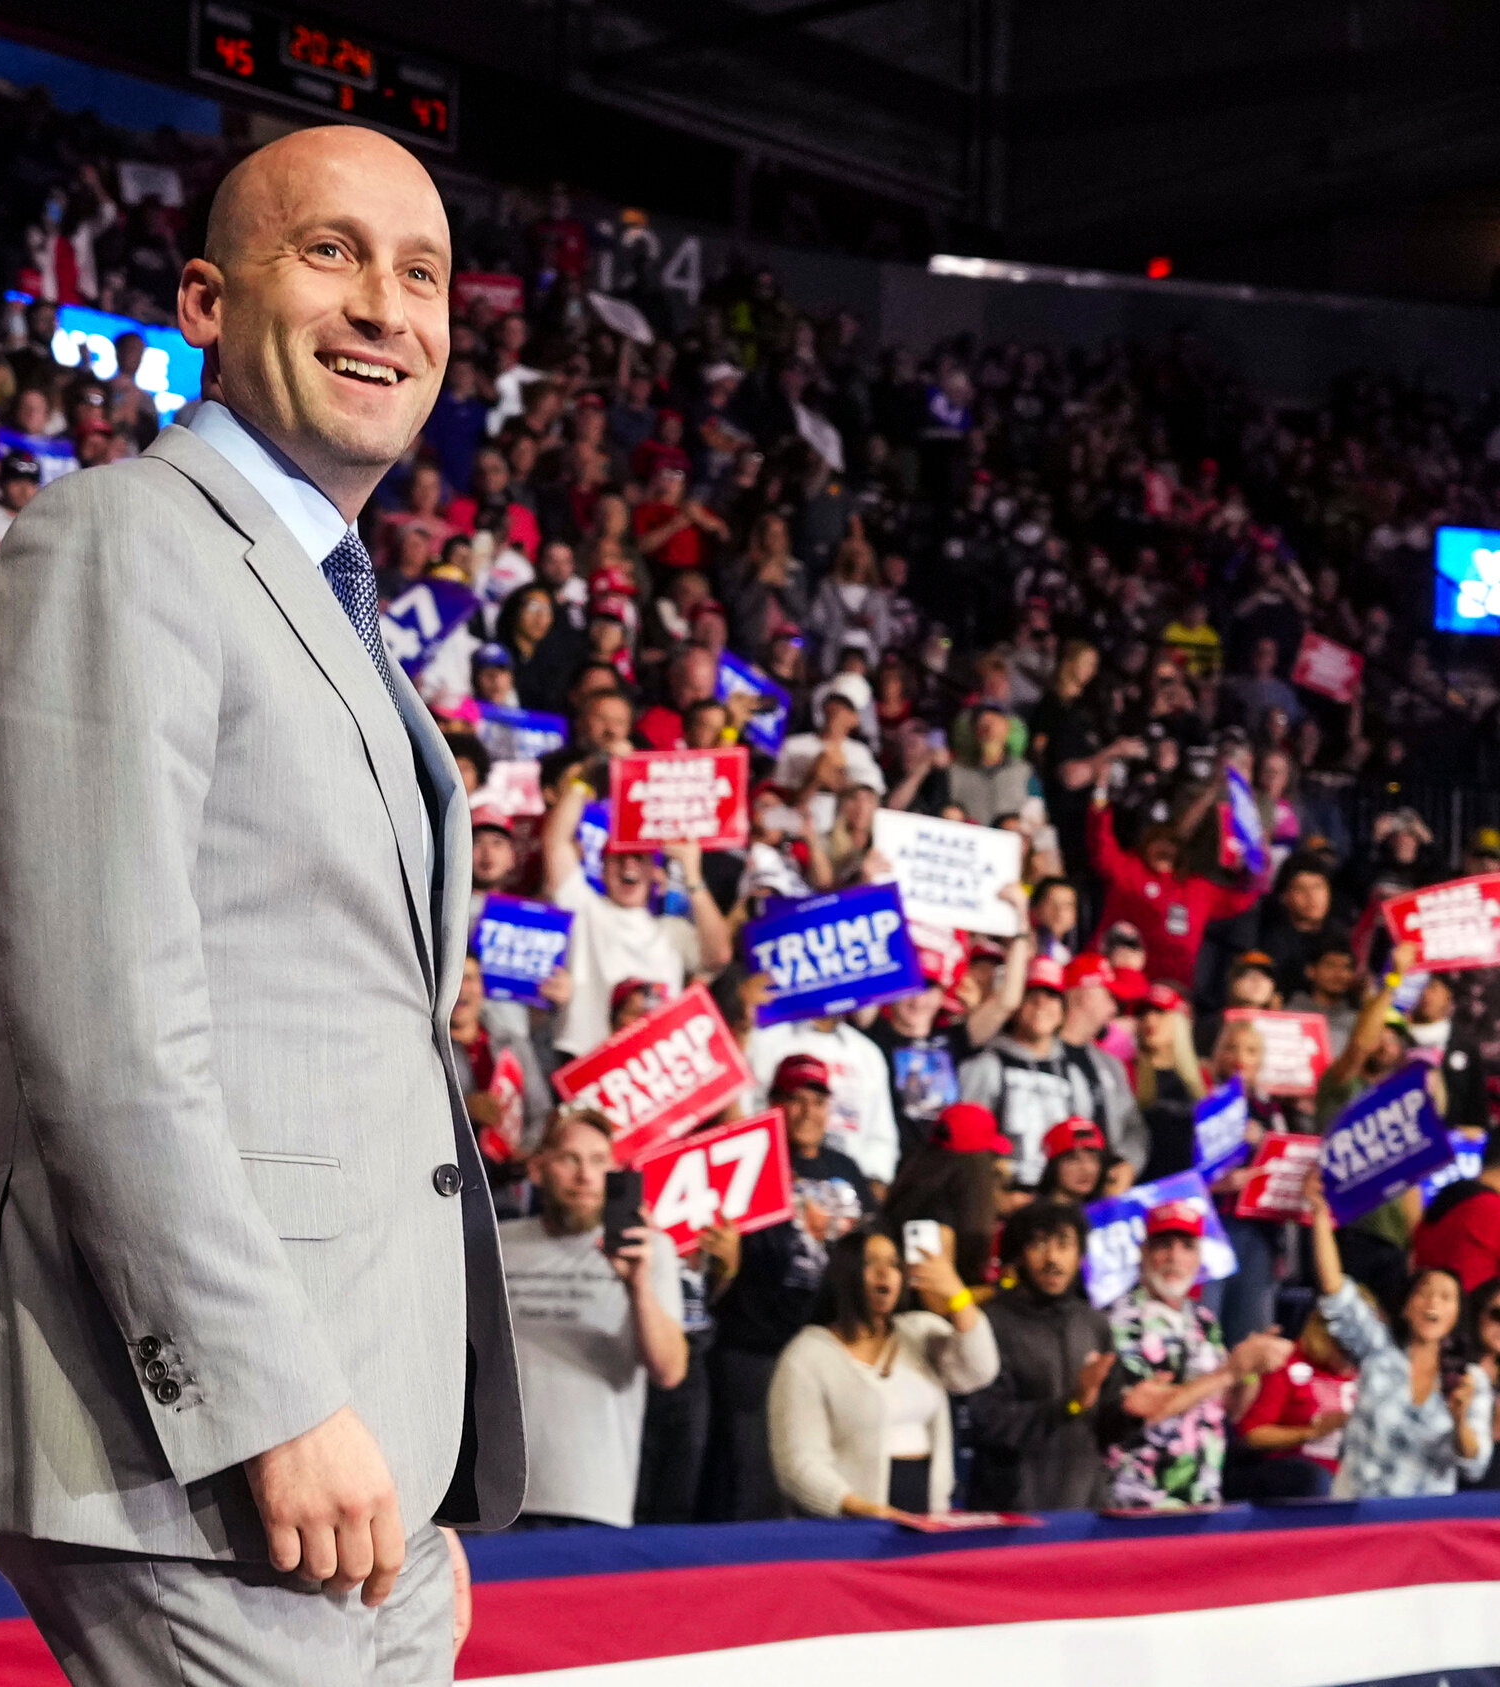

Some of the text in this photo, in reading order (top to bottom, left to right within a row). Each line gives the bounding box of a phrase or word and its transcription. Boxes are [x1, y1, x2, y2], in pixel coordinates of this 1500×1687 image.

[216, 35, 254, 76] 45
[411, 98, 447, 131] 47
[52, 329, 169, 392] VOE
[647, 757, 715, 781] MAKE
[916, 830, 978, 853] MAKE
[480, 918, 567, 954] TRUMP
[752, 909, 901, 972] TRUMP
[769, 938, 892, 987] VANCE
[572, 1014, 716, 1113] TRUMP
[1318, 1089, 1426, 1168] TRUMP
[652, 1127, 770, 1230] 47
